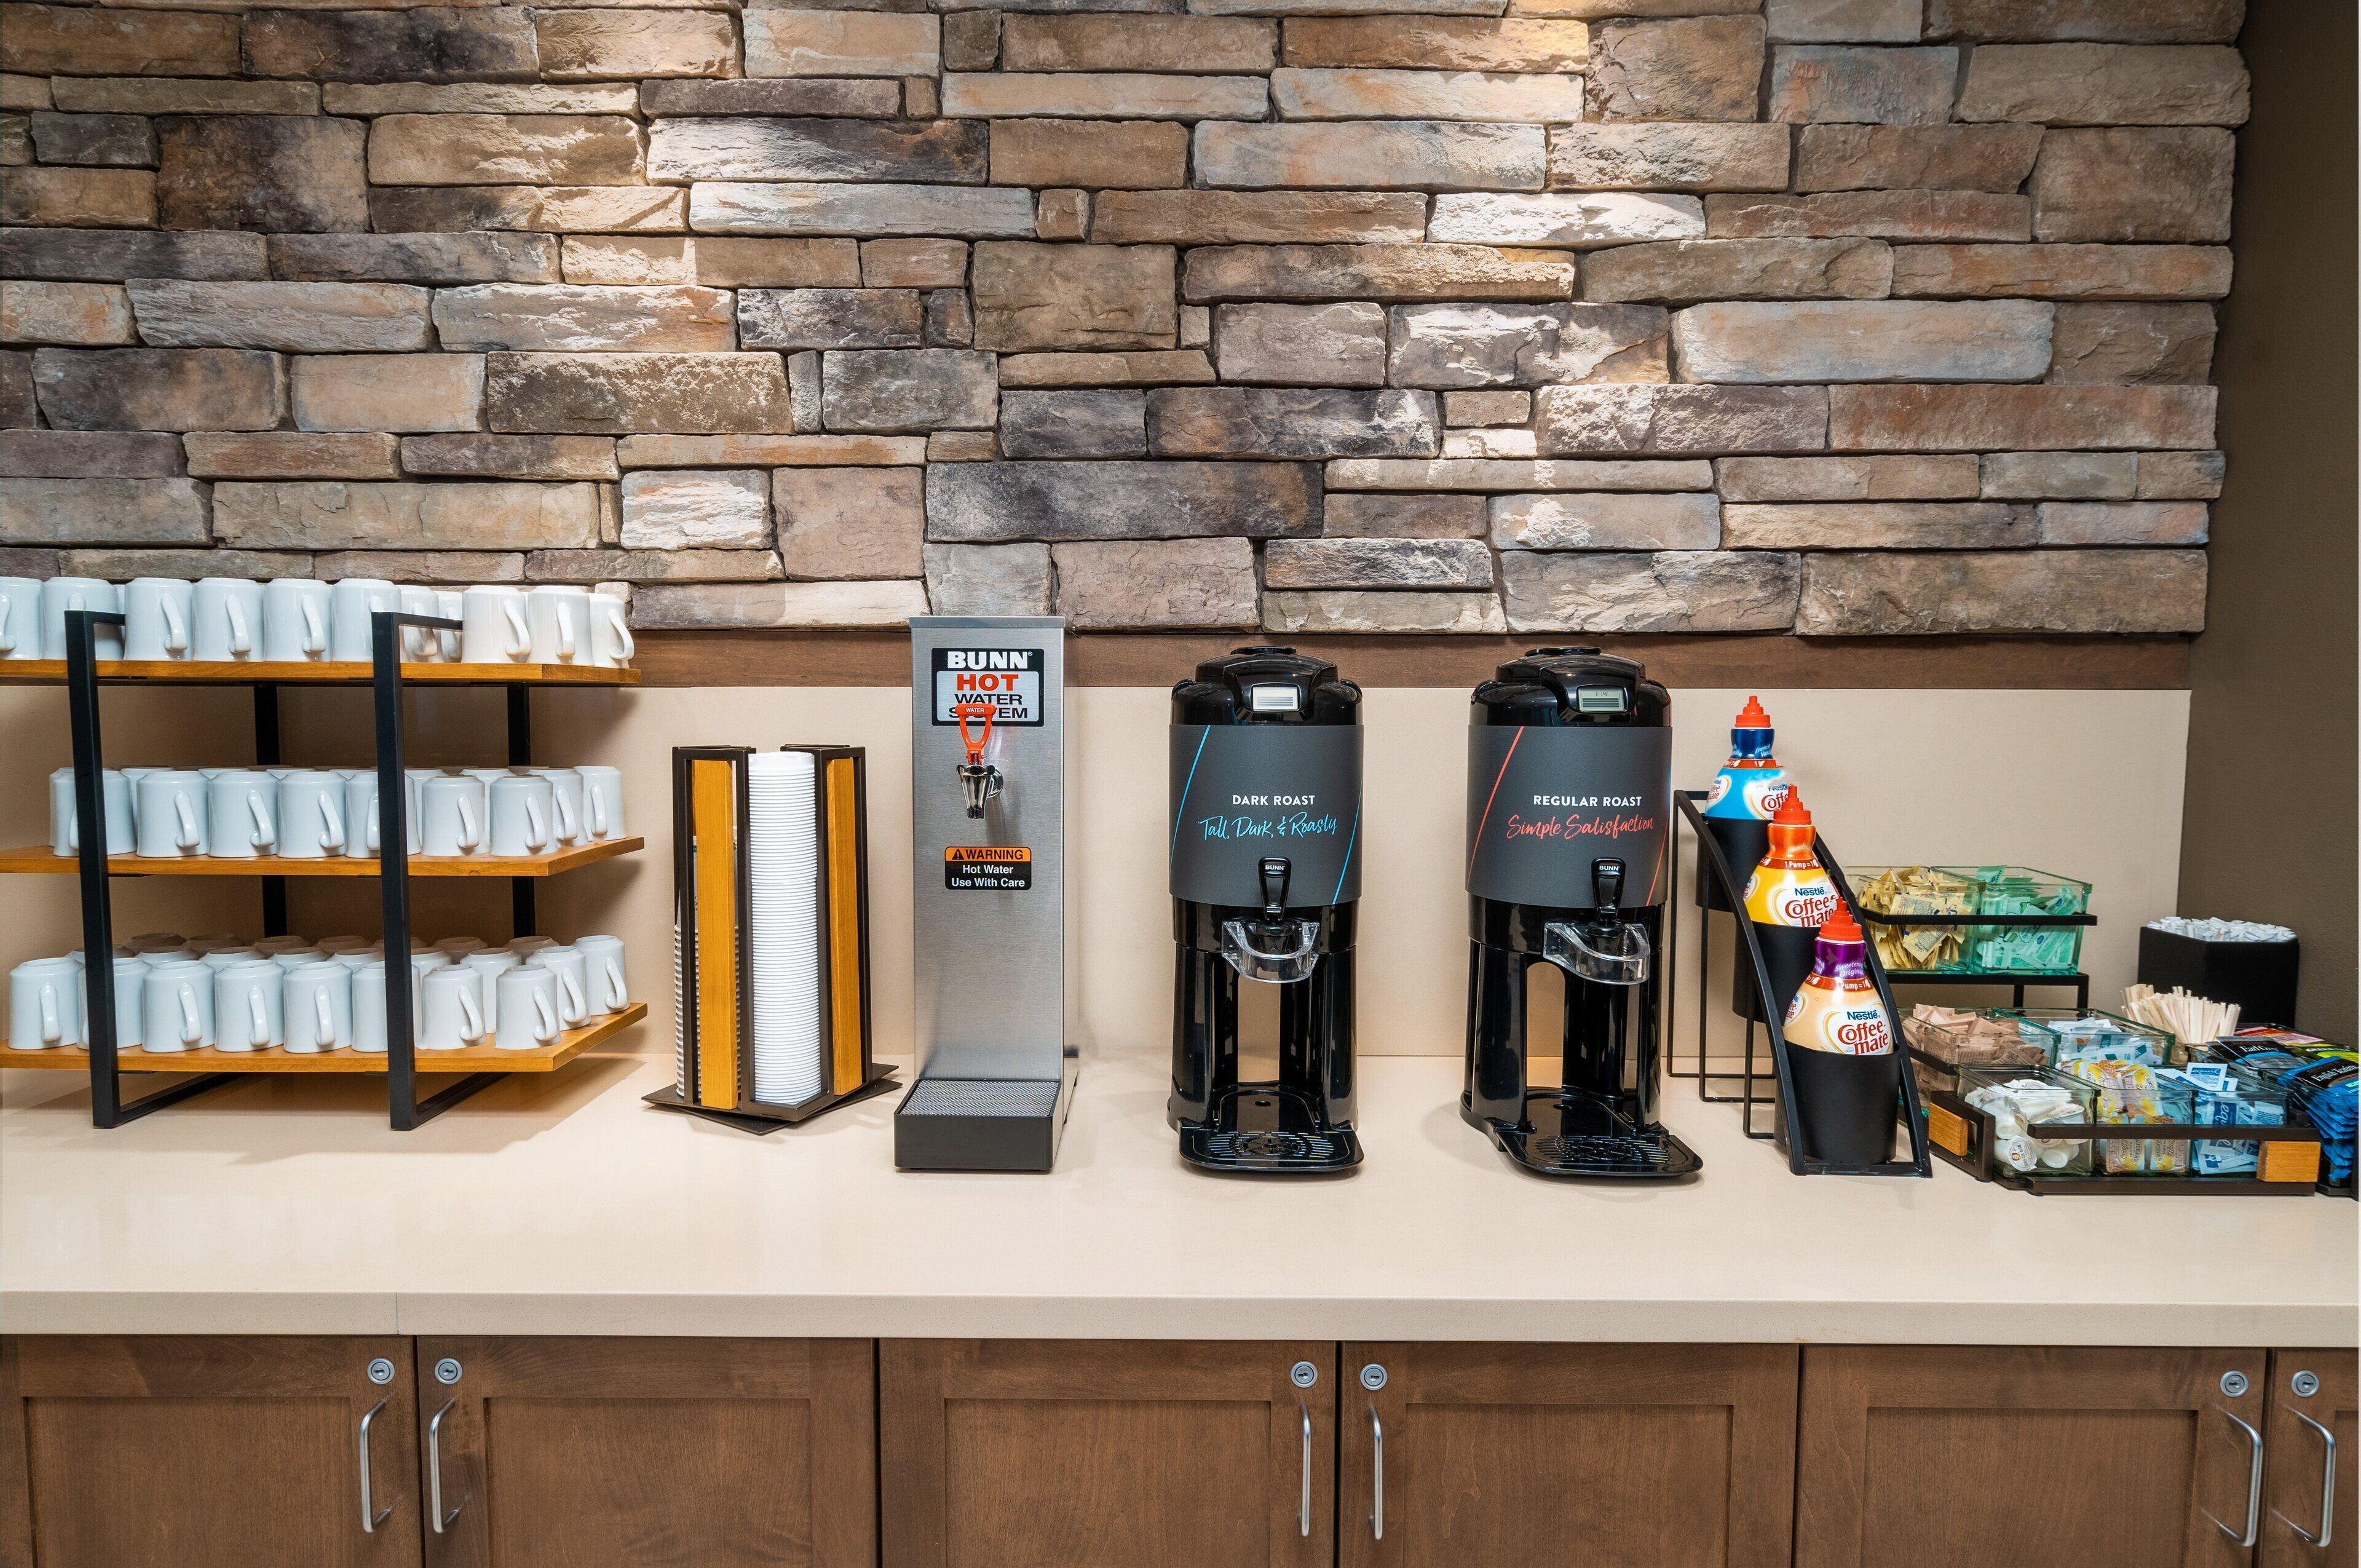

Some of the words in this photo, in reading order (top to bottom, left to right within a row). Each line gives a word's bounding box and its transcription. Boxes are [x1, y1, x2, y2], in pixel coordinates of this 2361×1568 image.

[947, 651, 1028, 670] BUNN
[957, 673, 1018, 691] HOT
[954, 694, 1022, 705] WATER
[949, 707, 1027, 719] SEM
[1232, 794, 1268, 806] DARK
[1273, 794, 1315, 806] ROAST
[1533, 794, 1598, 807] REGULAR
[1603, 796, 1642, 807] ROAST
[1198, 815, 1230, 840] Tall,
[1232, 816, 1274, 839] Dark,
[1289, 812, 1338, 838] Roasty
[1506, 814, 1562, 839] Simple
[1564, 814, 1654, 839] Satisfaction
[965, 849, 1024, 861] WARNING
[962, 865, 981, 874] Hot
[984, 865, 1014, 874] Water
[951, 877, 972, 887] Use
[974, 877, 998, 887] With
[1000, 877, 1025, 887] Care
[1794, 887, 1825, 897] Nestlé
[1846, 1009, 1878, 1021] Nestlé
[1853, 1032, 1889, 1056] mate
